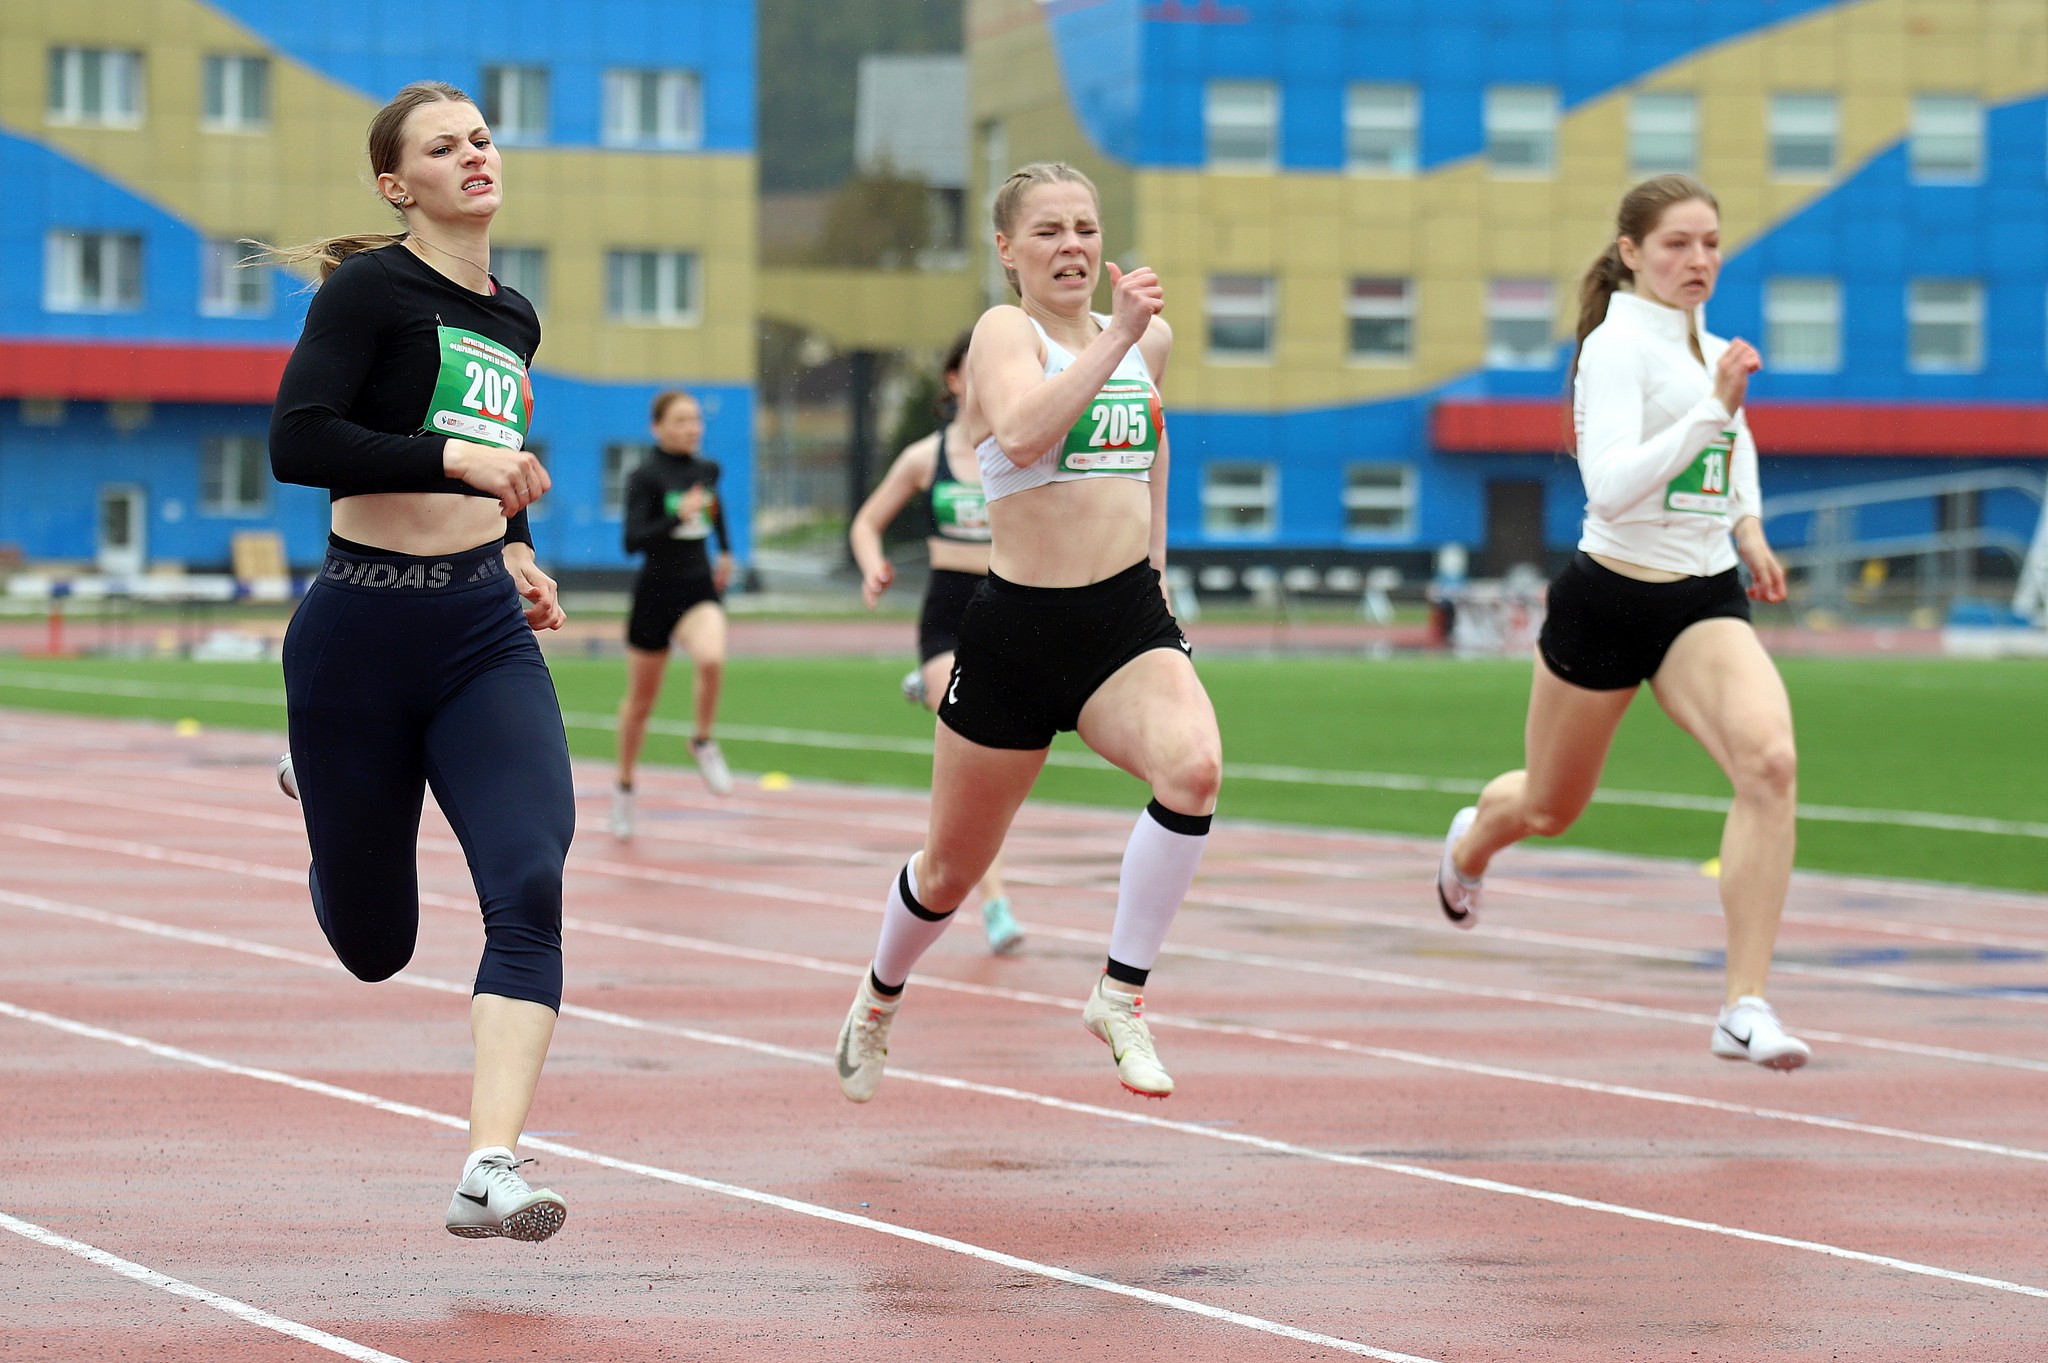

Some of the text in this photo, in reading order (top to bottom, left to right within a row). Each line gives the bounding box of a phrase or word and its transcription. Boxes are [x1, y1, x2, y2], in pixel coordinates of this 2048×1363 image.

[462, 361, 518, 423] 202
[1088, 403, 1147, 447] 205
[324, 557, 453, 589] DIDAS
